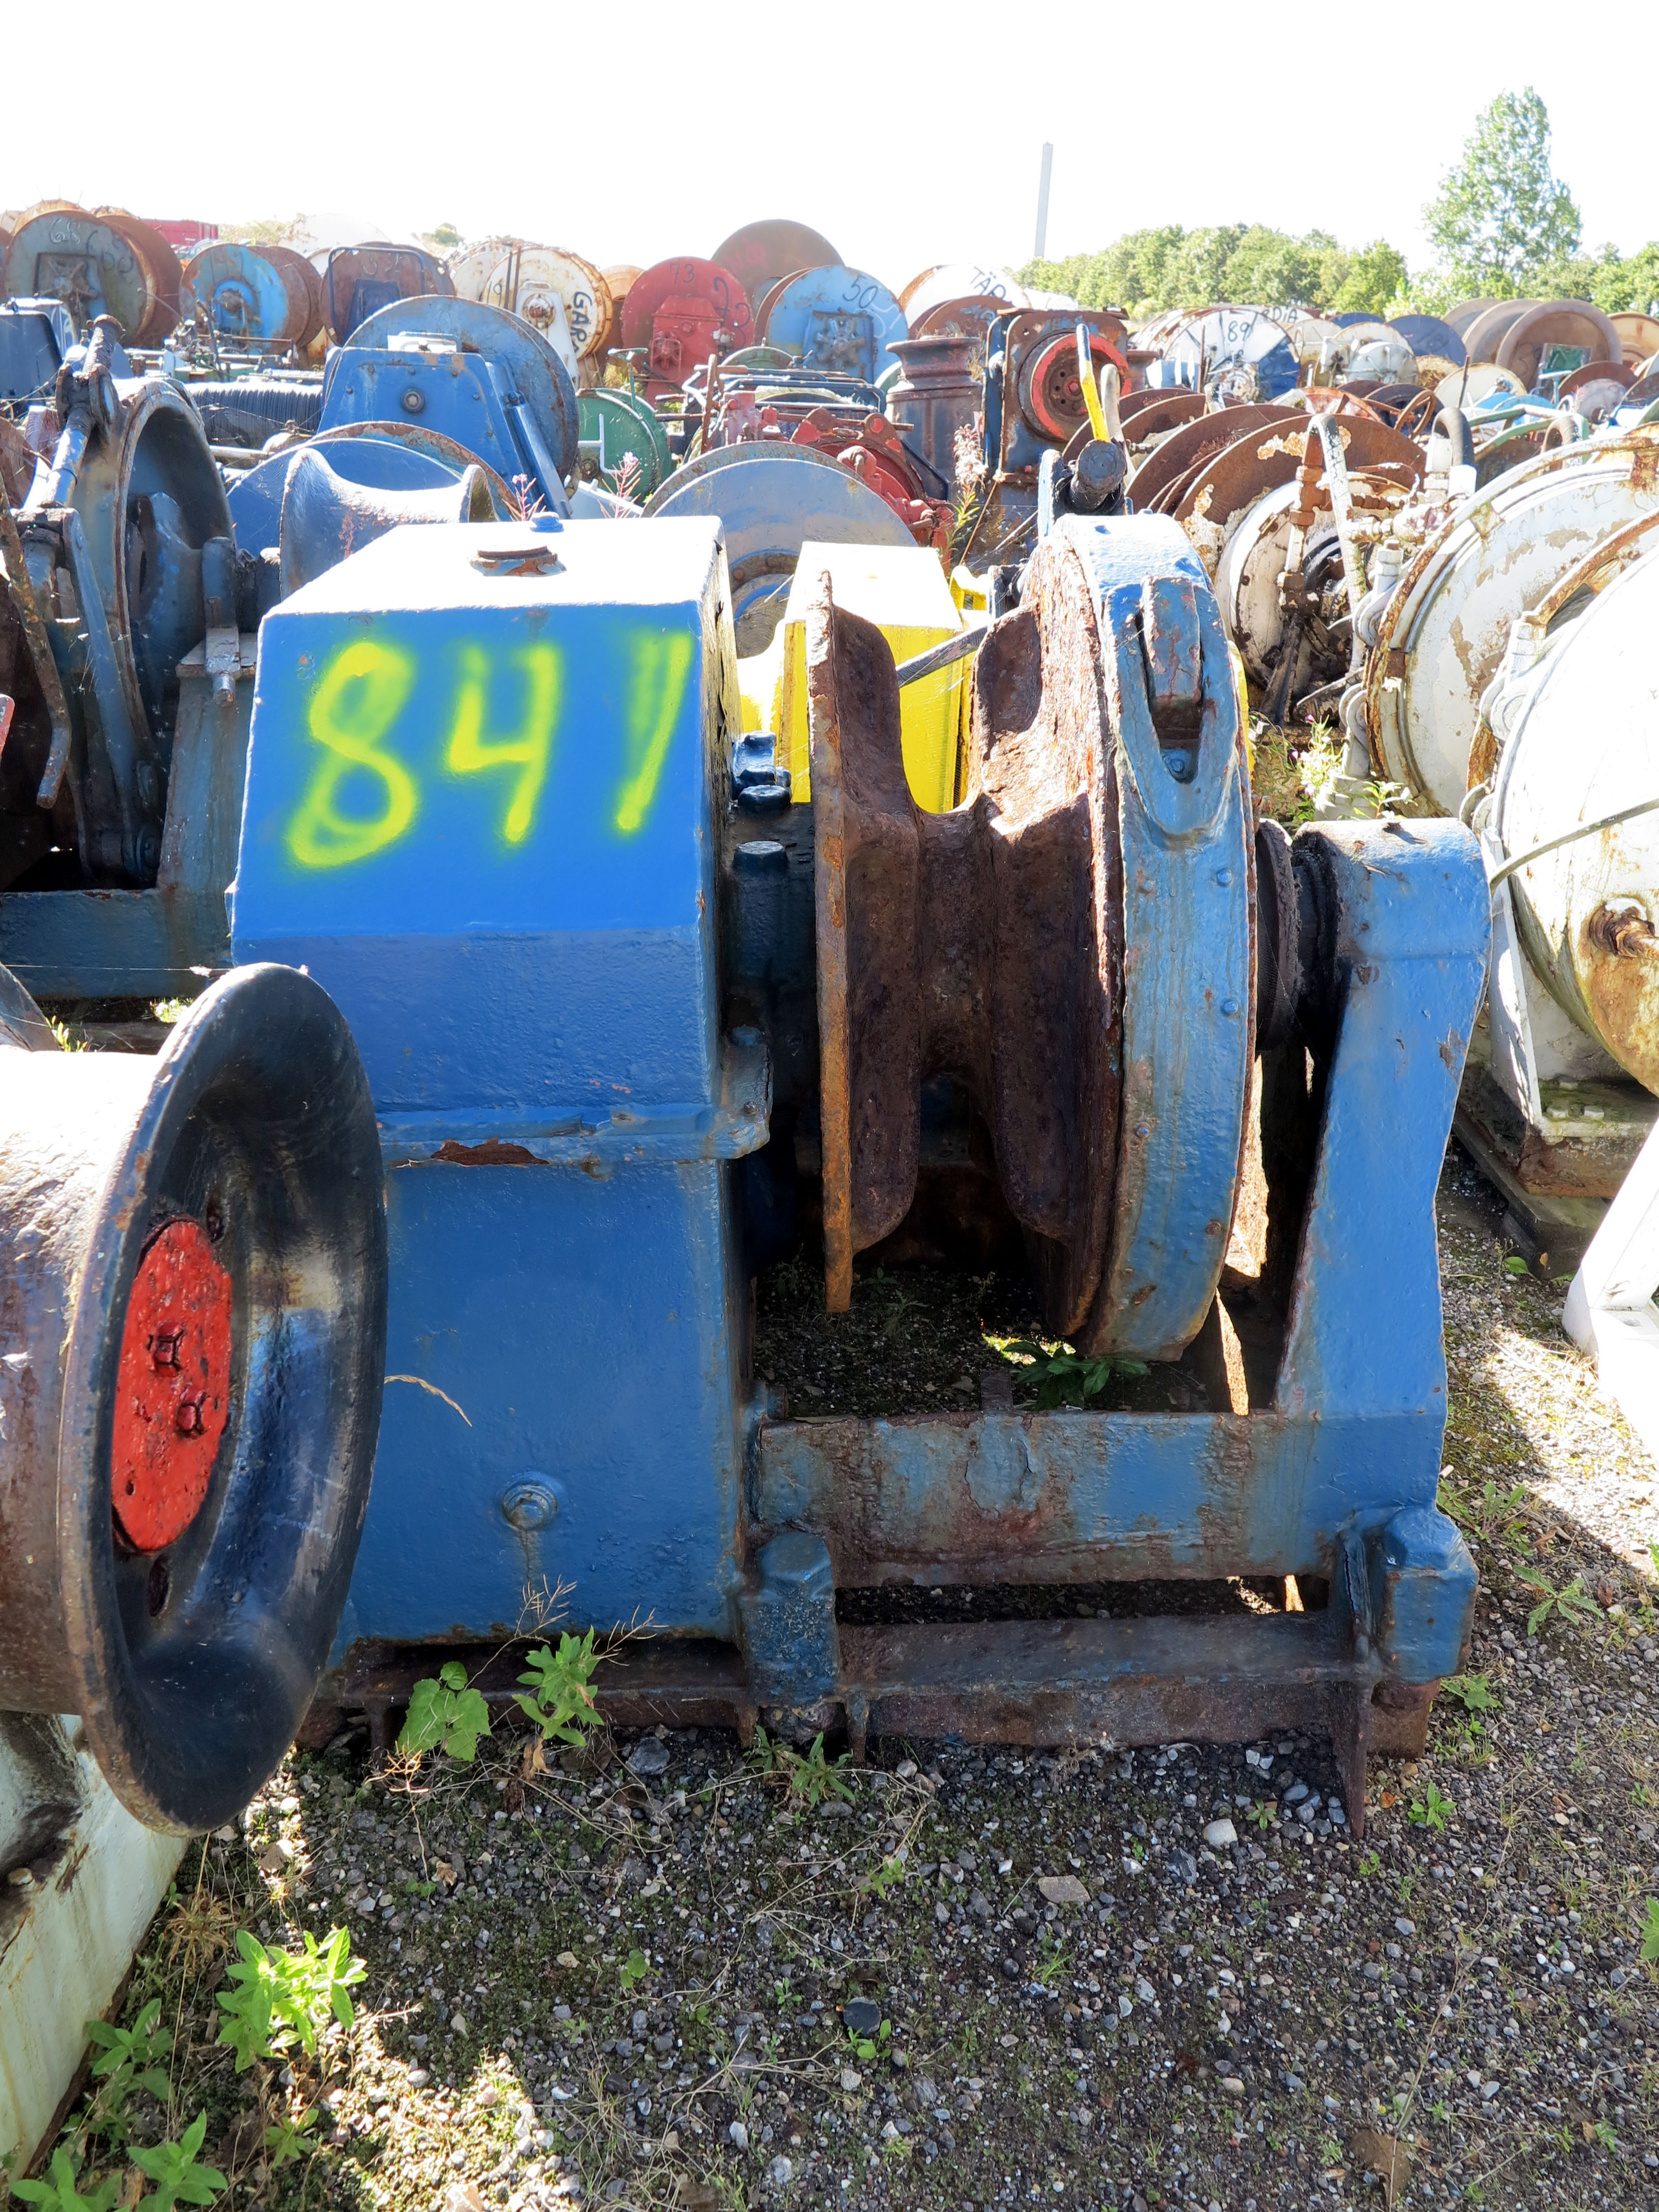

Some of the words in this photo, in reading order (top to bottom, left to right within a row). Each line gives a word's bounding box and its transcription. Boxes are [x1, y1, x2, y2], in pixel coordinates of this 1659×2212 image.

[669, 263, 695, 283] 73
[842, 275, 878, 309] 50
[1227, 320, 1249, 342] 89
[284, 635, 695, 872] 841
